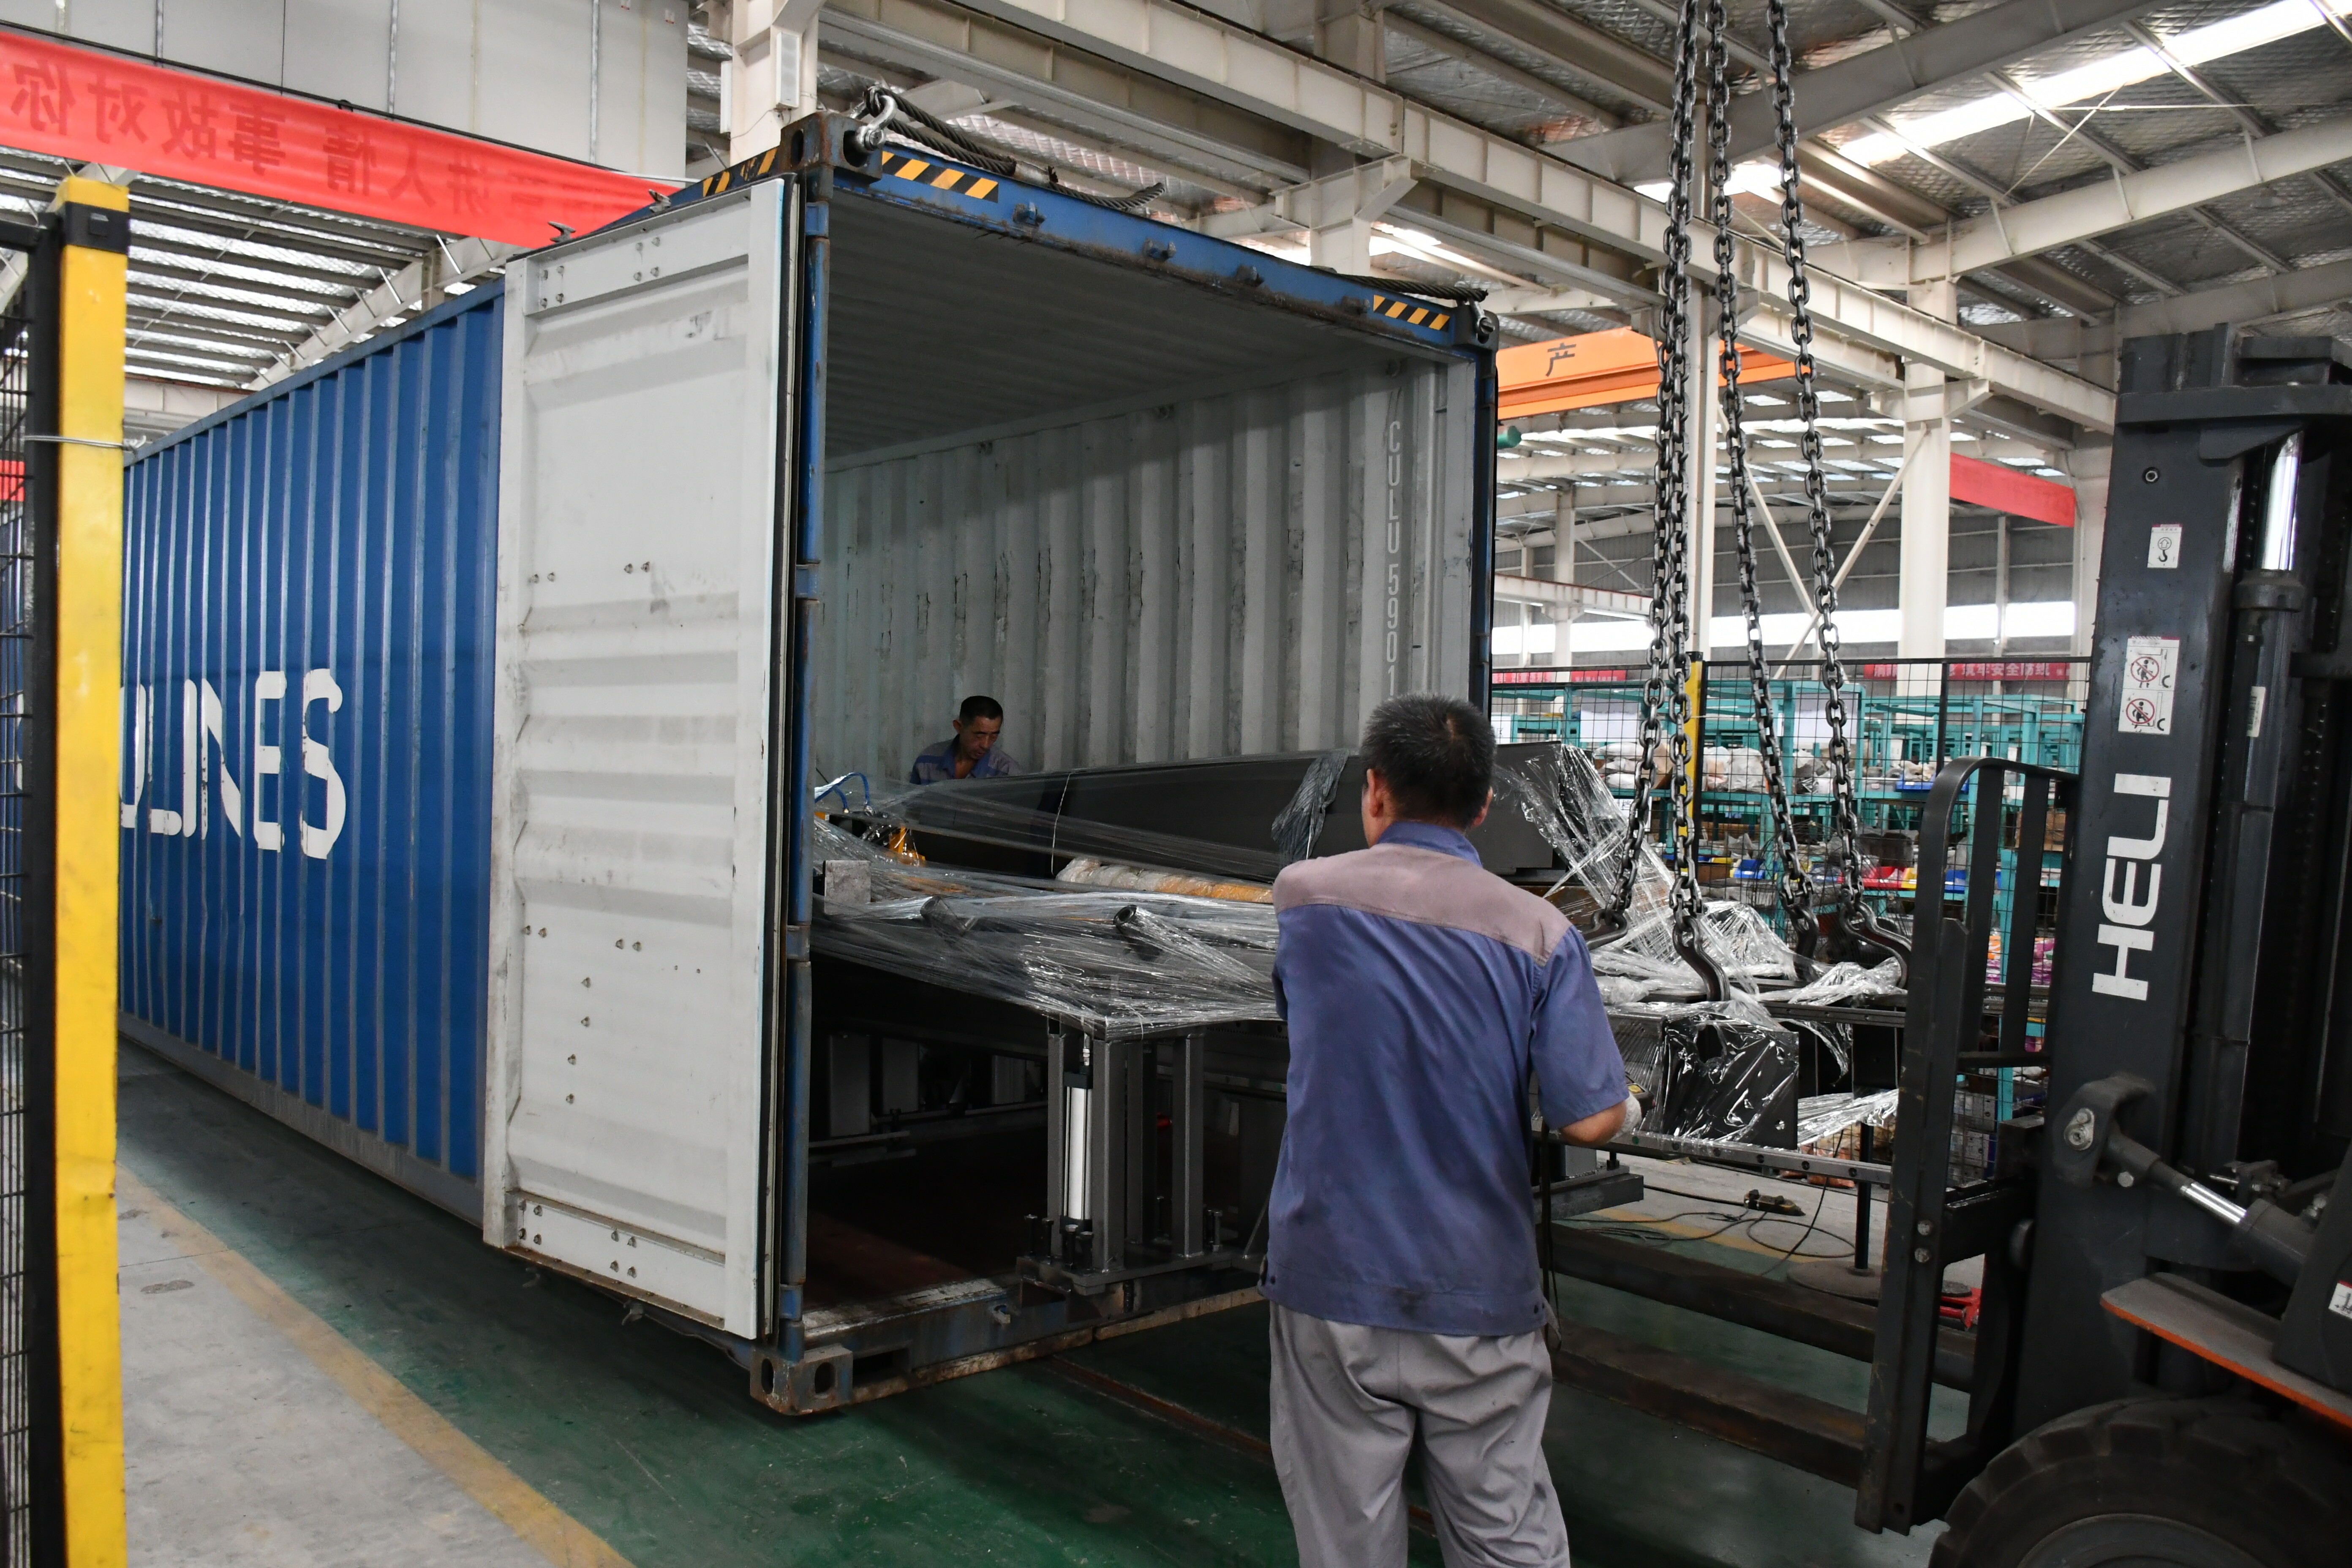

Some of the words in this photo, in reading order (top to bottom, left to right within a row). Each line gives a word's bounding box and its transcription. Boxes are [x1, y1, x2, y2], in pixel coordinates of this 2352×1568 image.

[1545, 343, 1576, 377] 产
[1388, 421, 1401, 554] CULU
[1386, 563, 1399, 697] 5901
[2091, 773, 2172, 1001] HELI
